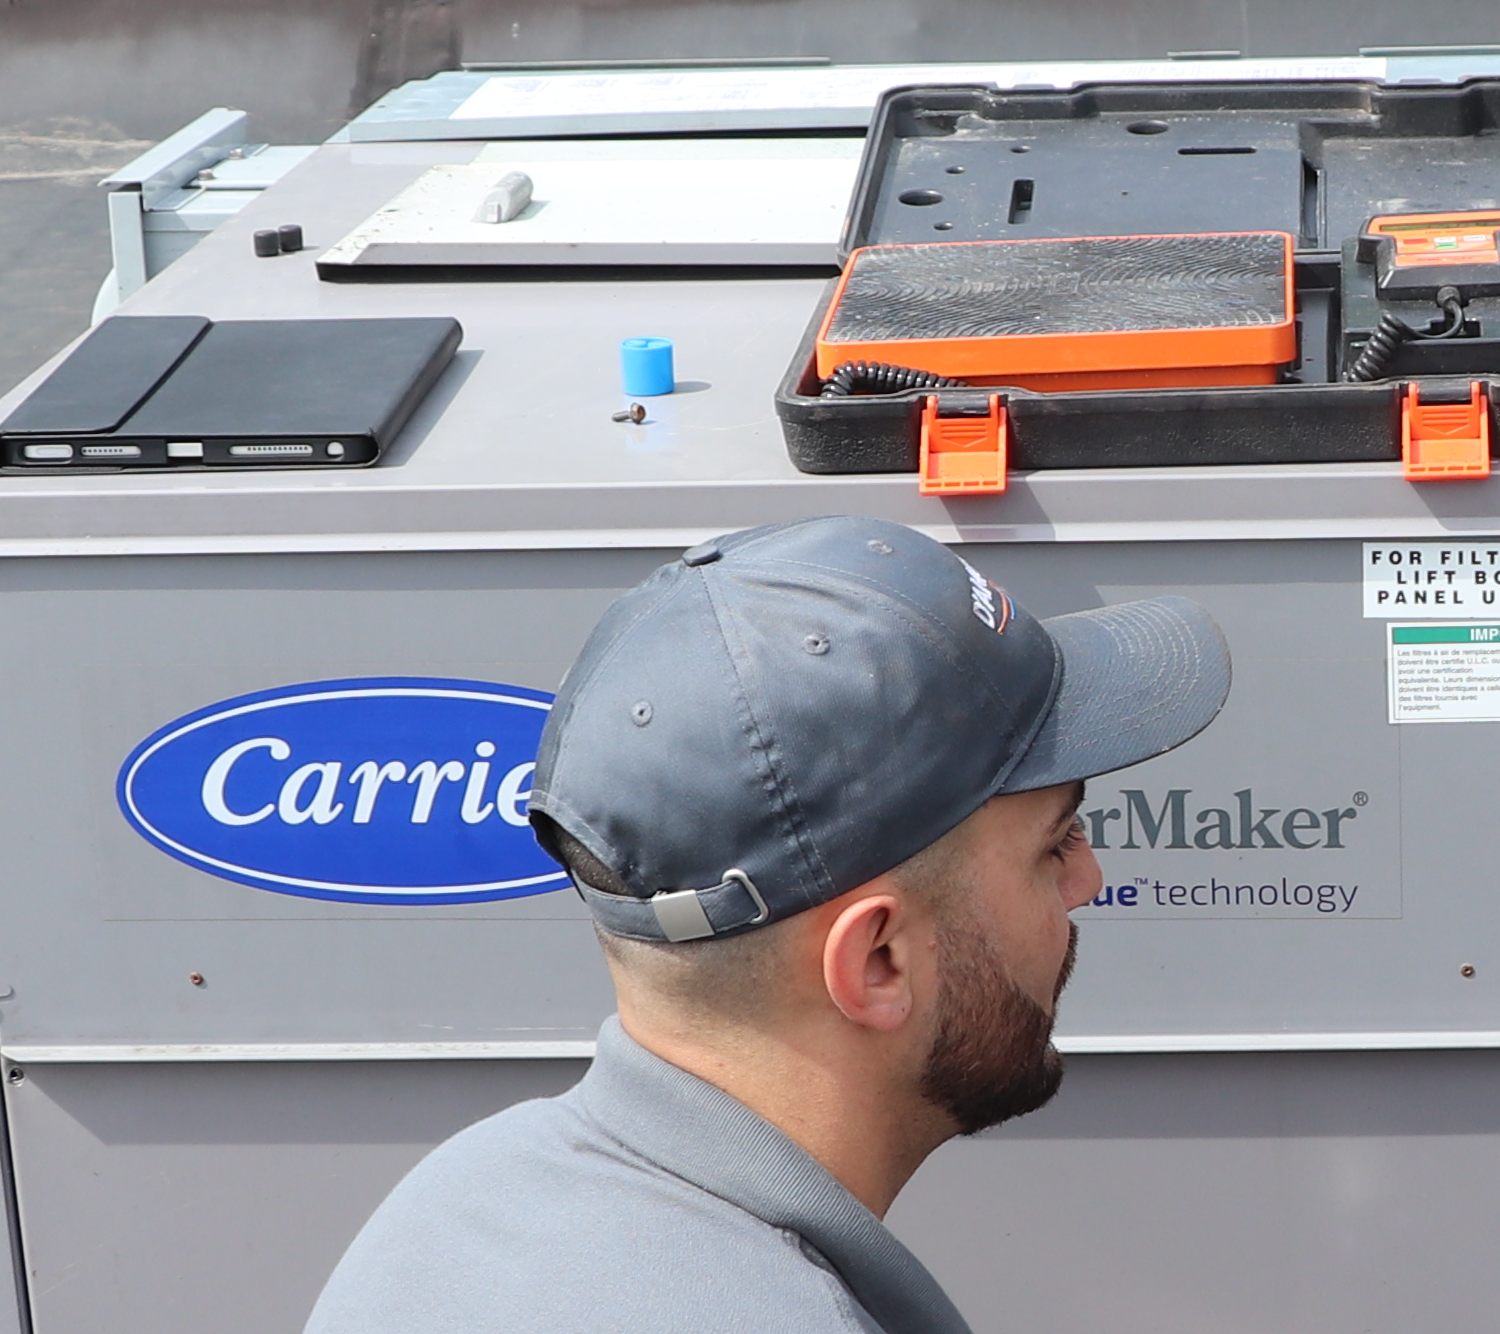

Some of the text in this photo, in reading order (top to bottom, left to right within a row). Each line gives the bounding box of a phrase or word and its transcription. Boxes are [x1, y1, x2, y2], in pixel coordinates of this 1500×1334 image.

[1370, 551, 1423, 565] FOR
[1397, 571, 1456, 585] LIFT
[1377, 591, 1465, 605] PANEL
[201, 737, 537, 826] Carrie
[1152, 878, 1358, 913] technology
